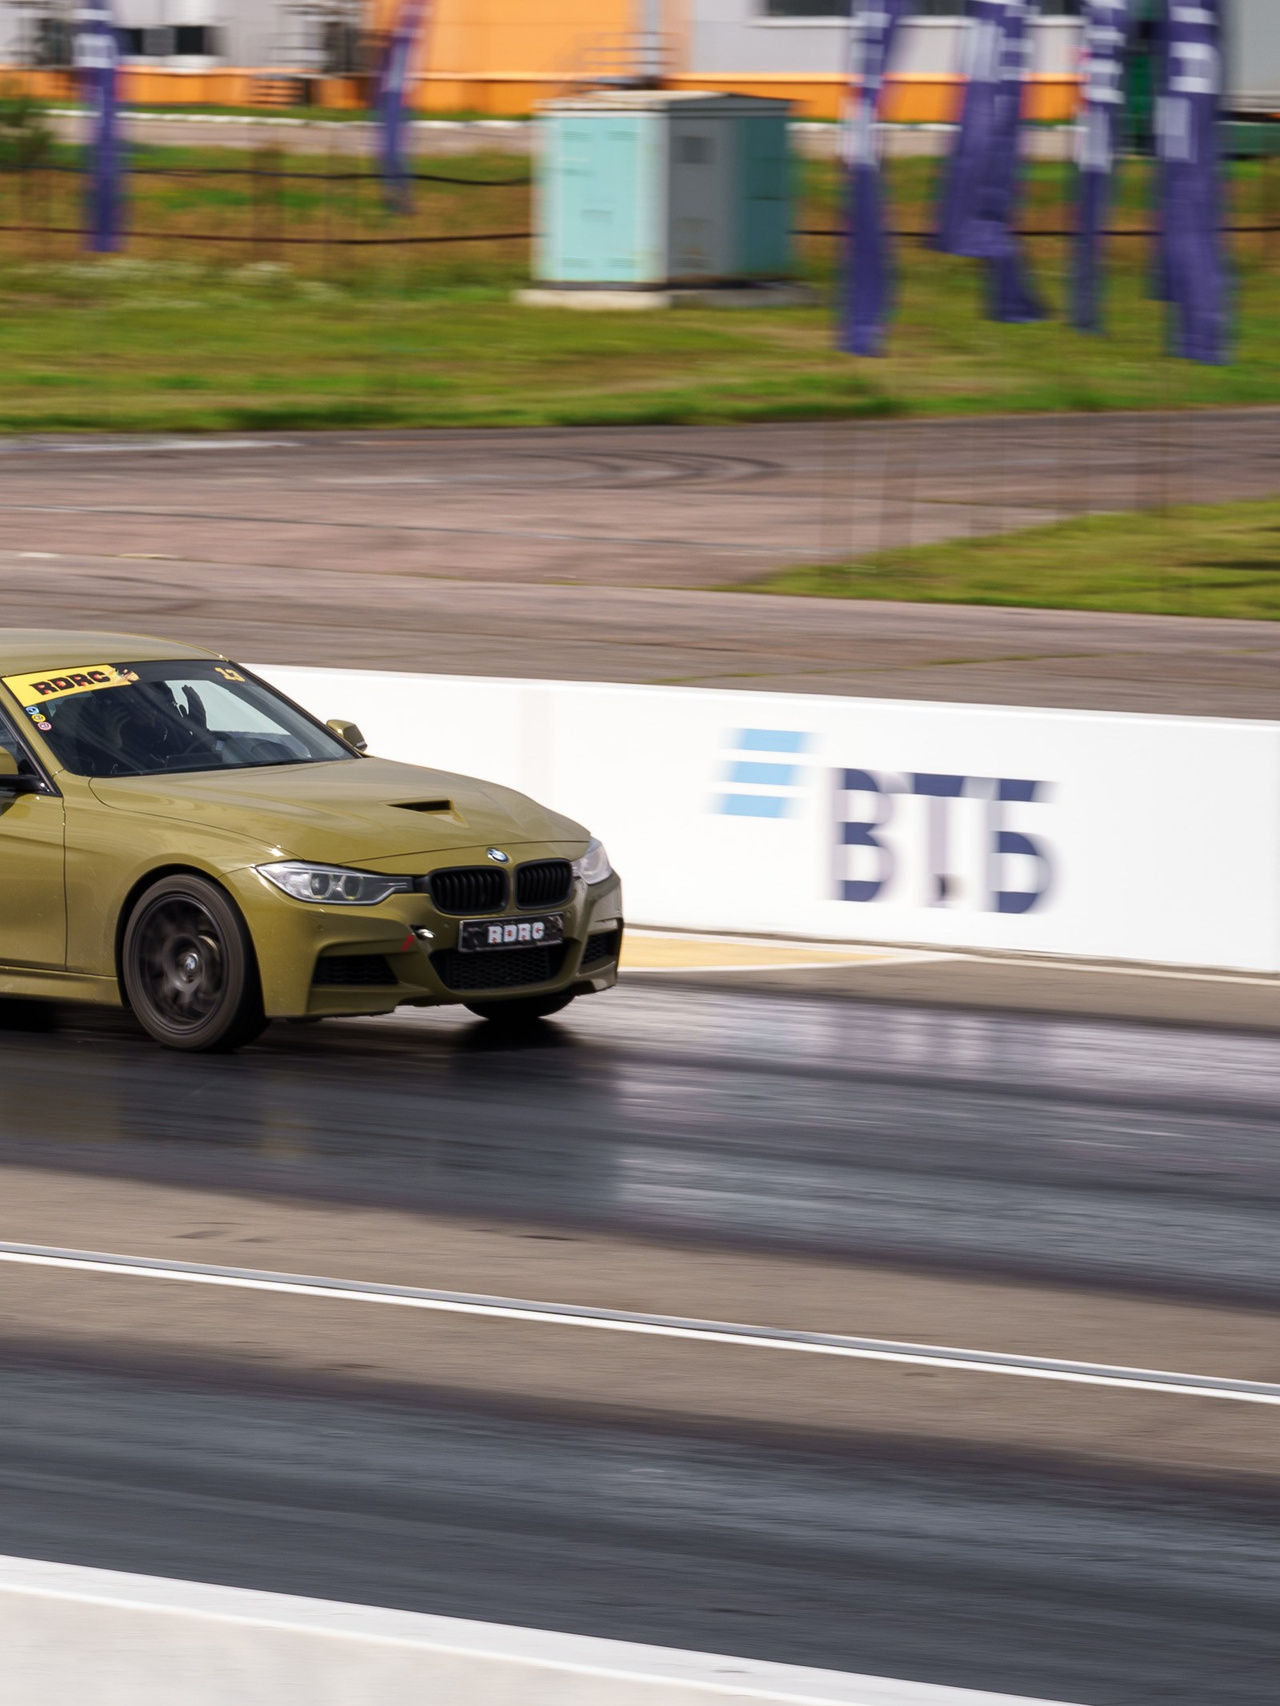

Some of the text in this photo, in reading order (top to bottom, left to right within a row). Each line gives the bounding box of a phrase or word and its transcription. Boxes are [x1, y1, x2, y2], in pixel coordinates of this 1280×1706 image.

[29, 670, 111, 696] RDRC
[214, 667, 245, 682] 13
[828, 767, 1060, 914] ВТБ
[487, 921, 546, 944] RDRC
